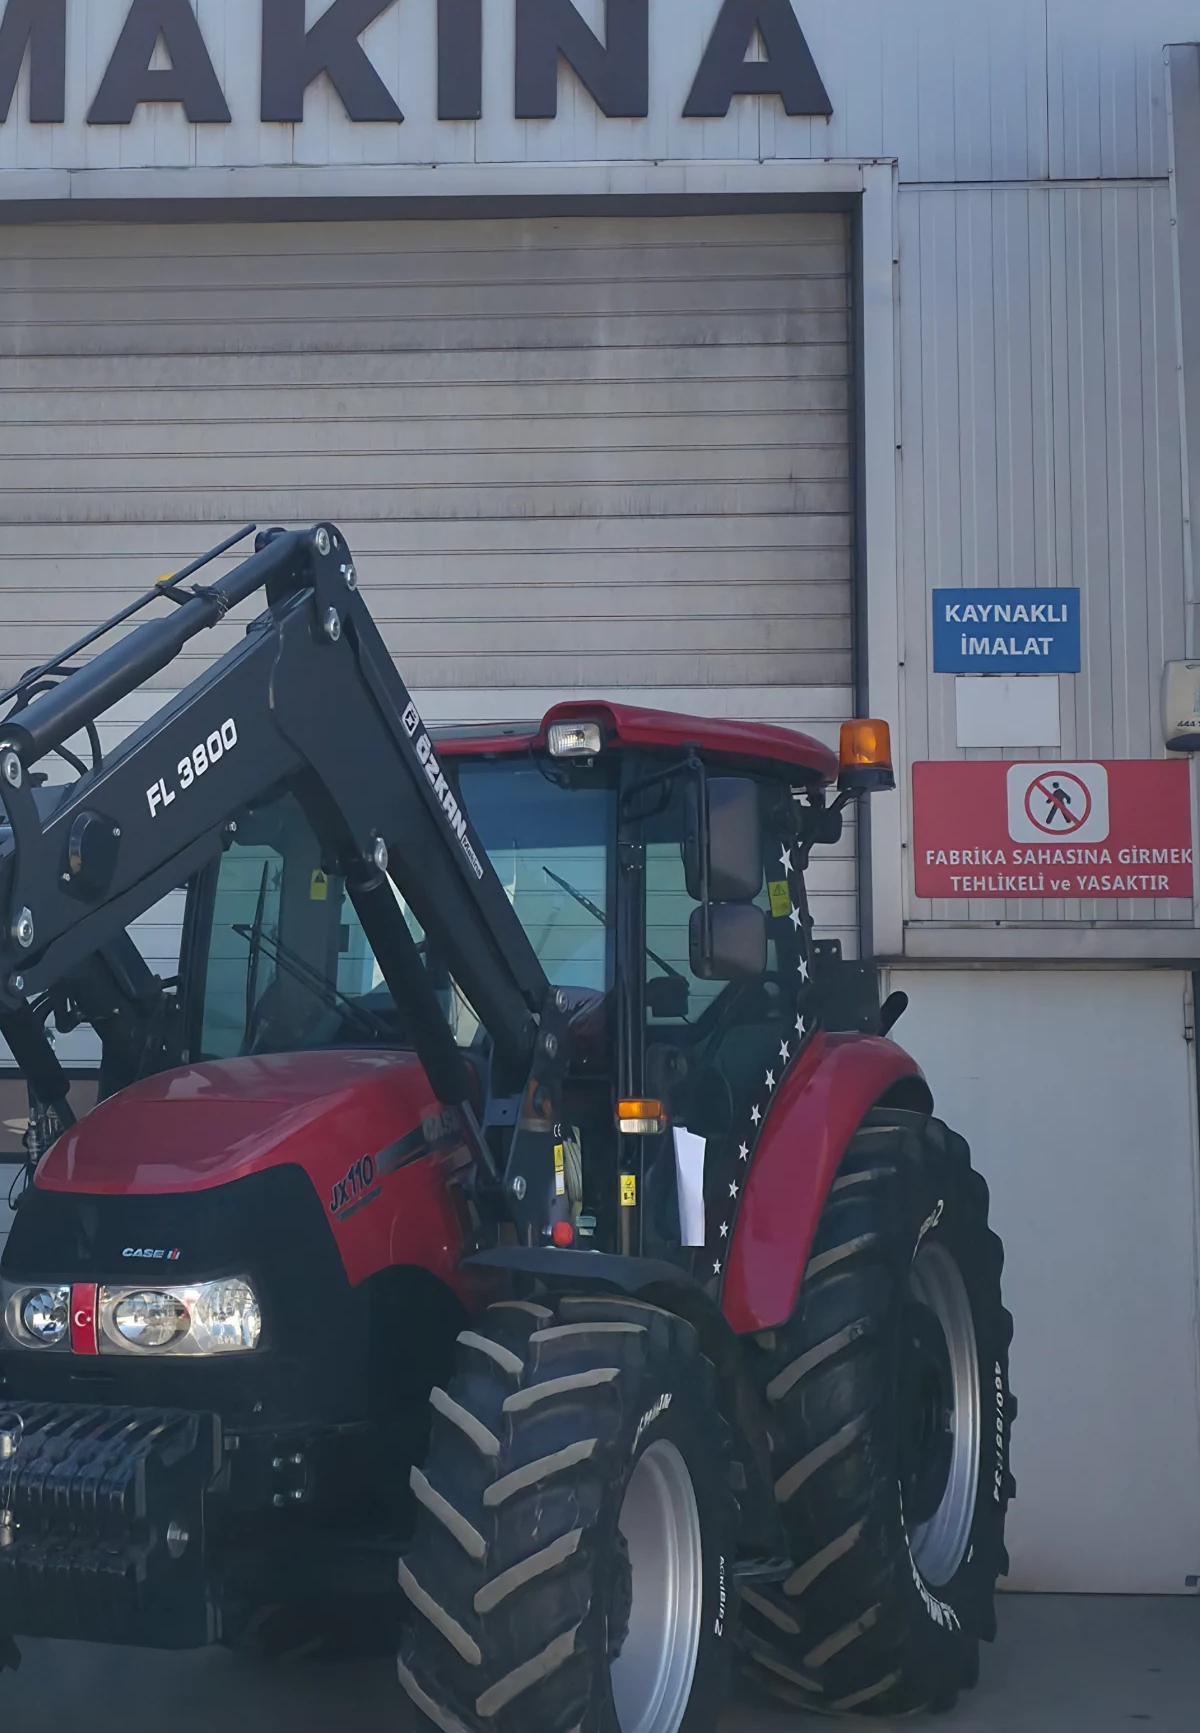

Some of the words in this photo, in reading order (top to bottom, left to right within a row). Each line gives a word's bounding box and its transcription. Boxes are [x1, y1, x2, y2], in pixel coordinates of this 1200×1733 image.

[945, 604, 1068, 623] KAYNAKLI
[960, 632, 1054, 655] İMALAT
[146, 777, 176, 818] FL
[177, 718, 238, 789] 3800
[416, 733, 467, 839] ÖZKAN
[926, 846, 1005, 865] FABRİKA
[1012, 848, 1112, 865] SAHASINA
[1118, 845, 1193, 865] GİRMEK
[950, 872, 1045, 891] TEHLİKELİ
[1051, 879, 1071, 891] ve
[1076, 874, 1170, 891] YASAKTIR
[122, 1247, 164, 1258] CASE
